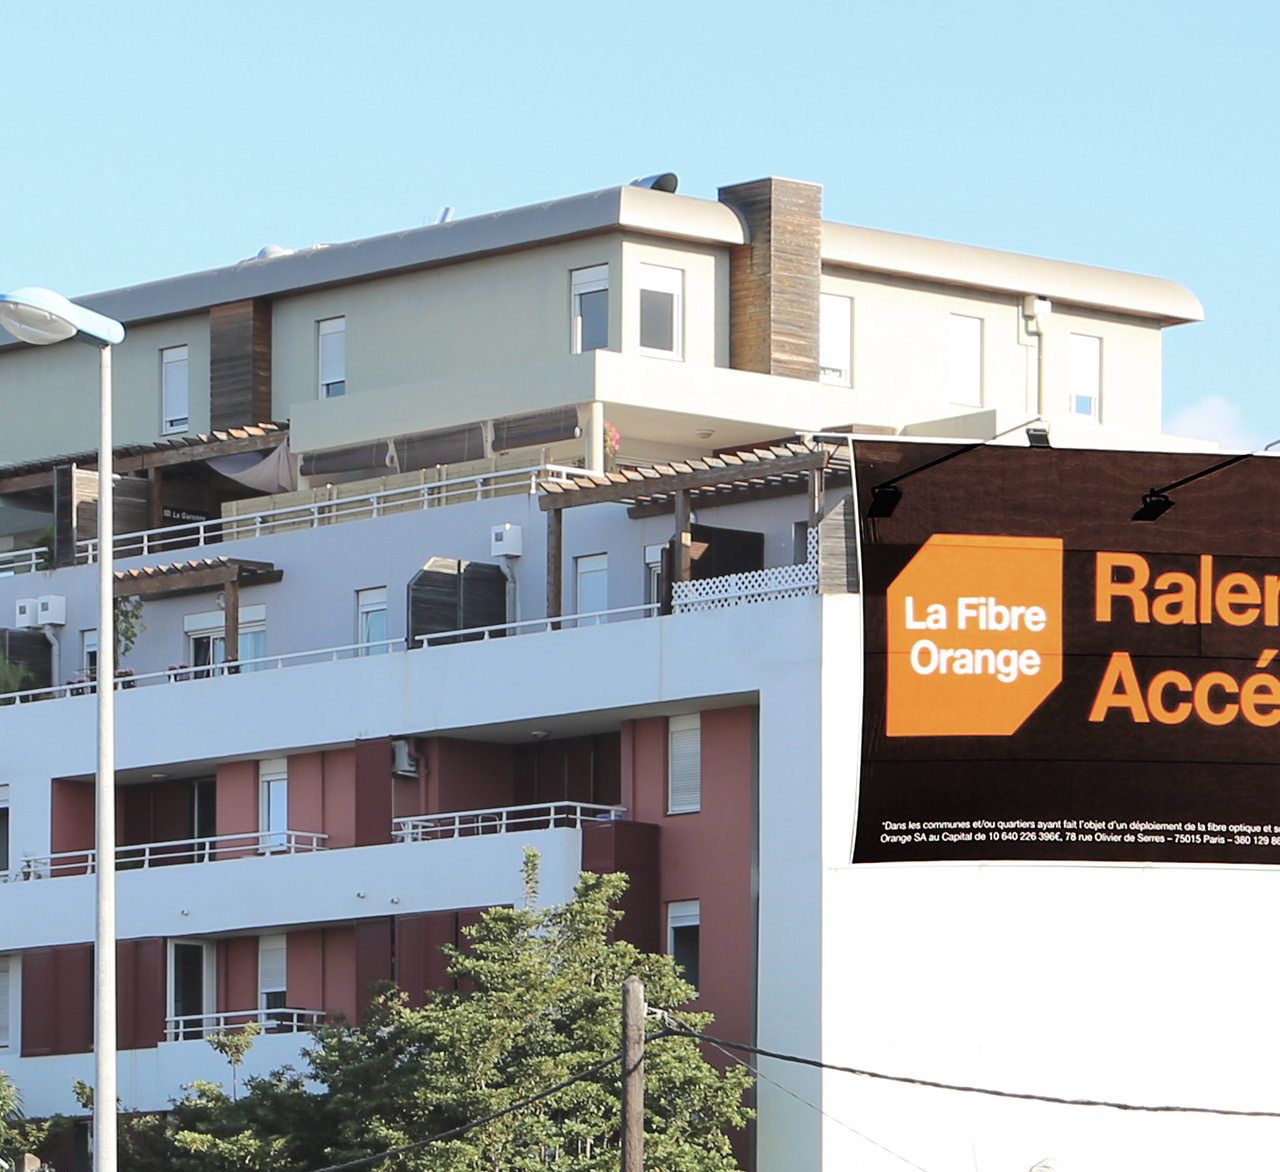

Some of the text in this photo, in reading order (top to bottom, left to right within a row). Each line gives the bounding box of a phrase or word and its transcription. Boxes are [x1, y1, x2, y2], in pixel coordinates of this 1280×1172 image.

[905, 596, 1048, 633] La Fibre
[910, 639, 1042, 684] Orange
[880, 833, 912, 845] Orange
[914, 832, 927, 843] SA
[928, 833, 940, 842] au
[942, 831, 972, 843] Capital
[974, 831, 986, 841] de
[989, 831, 1000, 841] 10
[1001, 831, 1018, 841] 640
[1020, 831, 1036, 841] 226
[1065, 831, 1077, 842] 78
[1078, 833, 1093, 842] rue
[1094, 831, 1122, 843] Olivier
[1124, 833, 1136, 843] de
[1137, 832, 1165, 843] Serres
[1174, 833, 1201, 844] 75015
[1203, 834, 1225, 845] Paris
[1234, 834, 1251, 845] 380
[1254, 835, 1269, 846] 129
[908, 820, 921, 830] les
[922, 821, 970, 830] communes
[972, 819, 996, 829] et/ou
[997, 819, 1035, 831] quartiers
[1037, 820, 1062, 831] ayant
[1063, 819, 1077, 830] fait
[1184, 821, 1196, 832] de
[1197, 821, 1206, 832] la
[1208, 821, 1227, 832] fibre
[1228, 822, 1262, 835] optique
[1263, 824, 1272, 834] et
